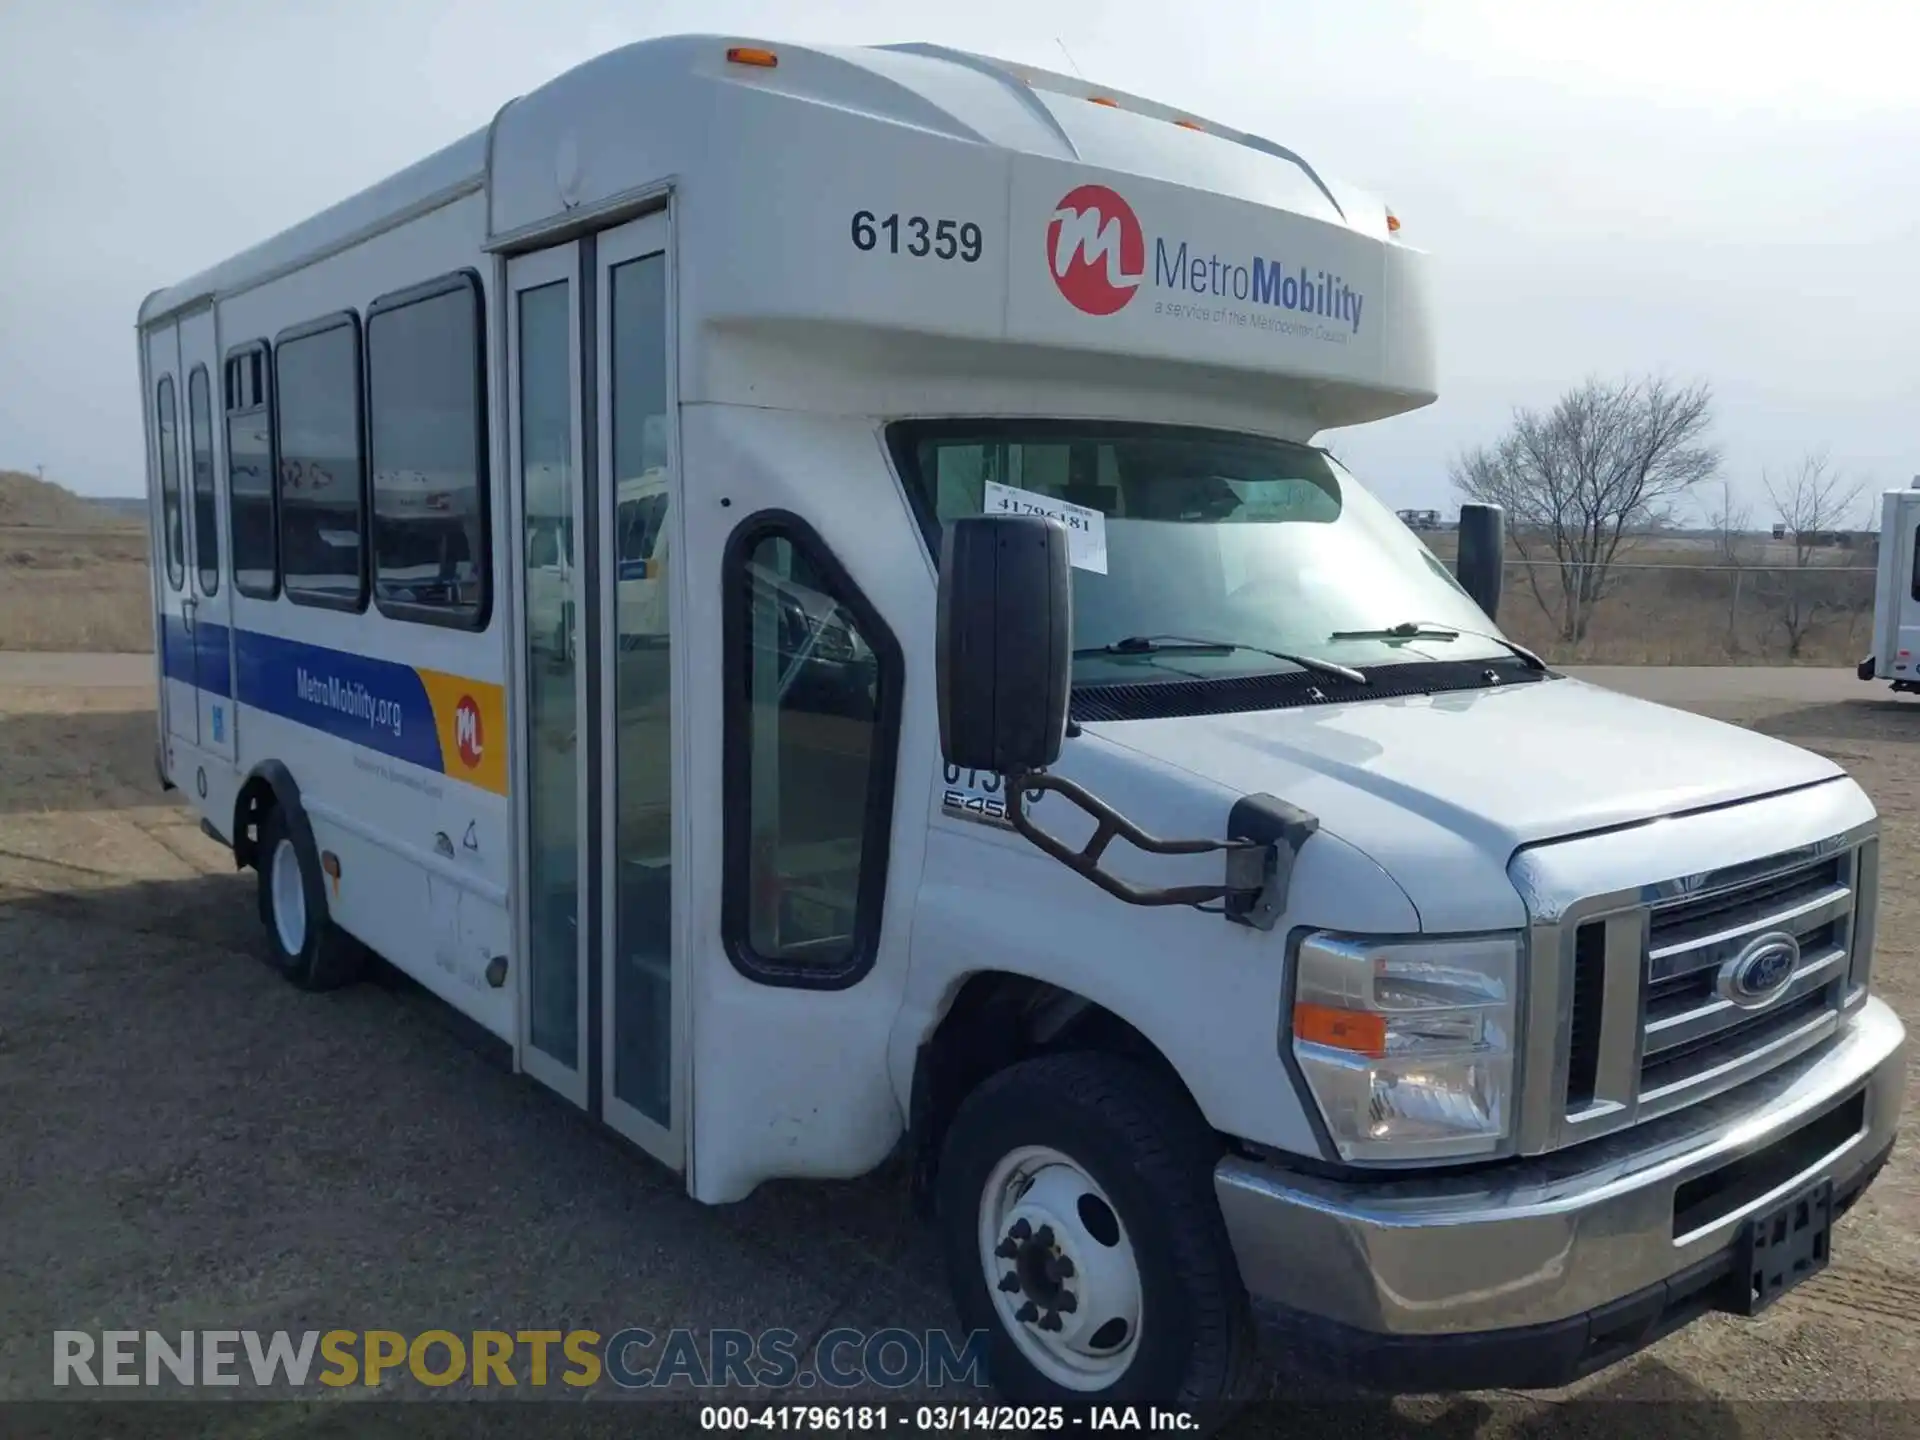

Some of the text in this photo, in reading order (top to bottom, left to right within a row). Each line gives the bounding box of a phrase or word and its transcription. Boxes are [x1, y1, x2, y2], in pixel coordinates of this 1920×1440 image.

[850, 210, 983, 262] 61359
[1154, 300, 1163, 314] a
[1165, 303, 1210, 321] service
[1213, 307, 1226, 323] of
[1227, 309, 1247, 327] the
[296, 667, 401, 737] MetroMobility.org
[943, 790, 1012, 820] E-45
